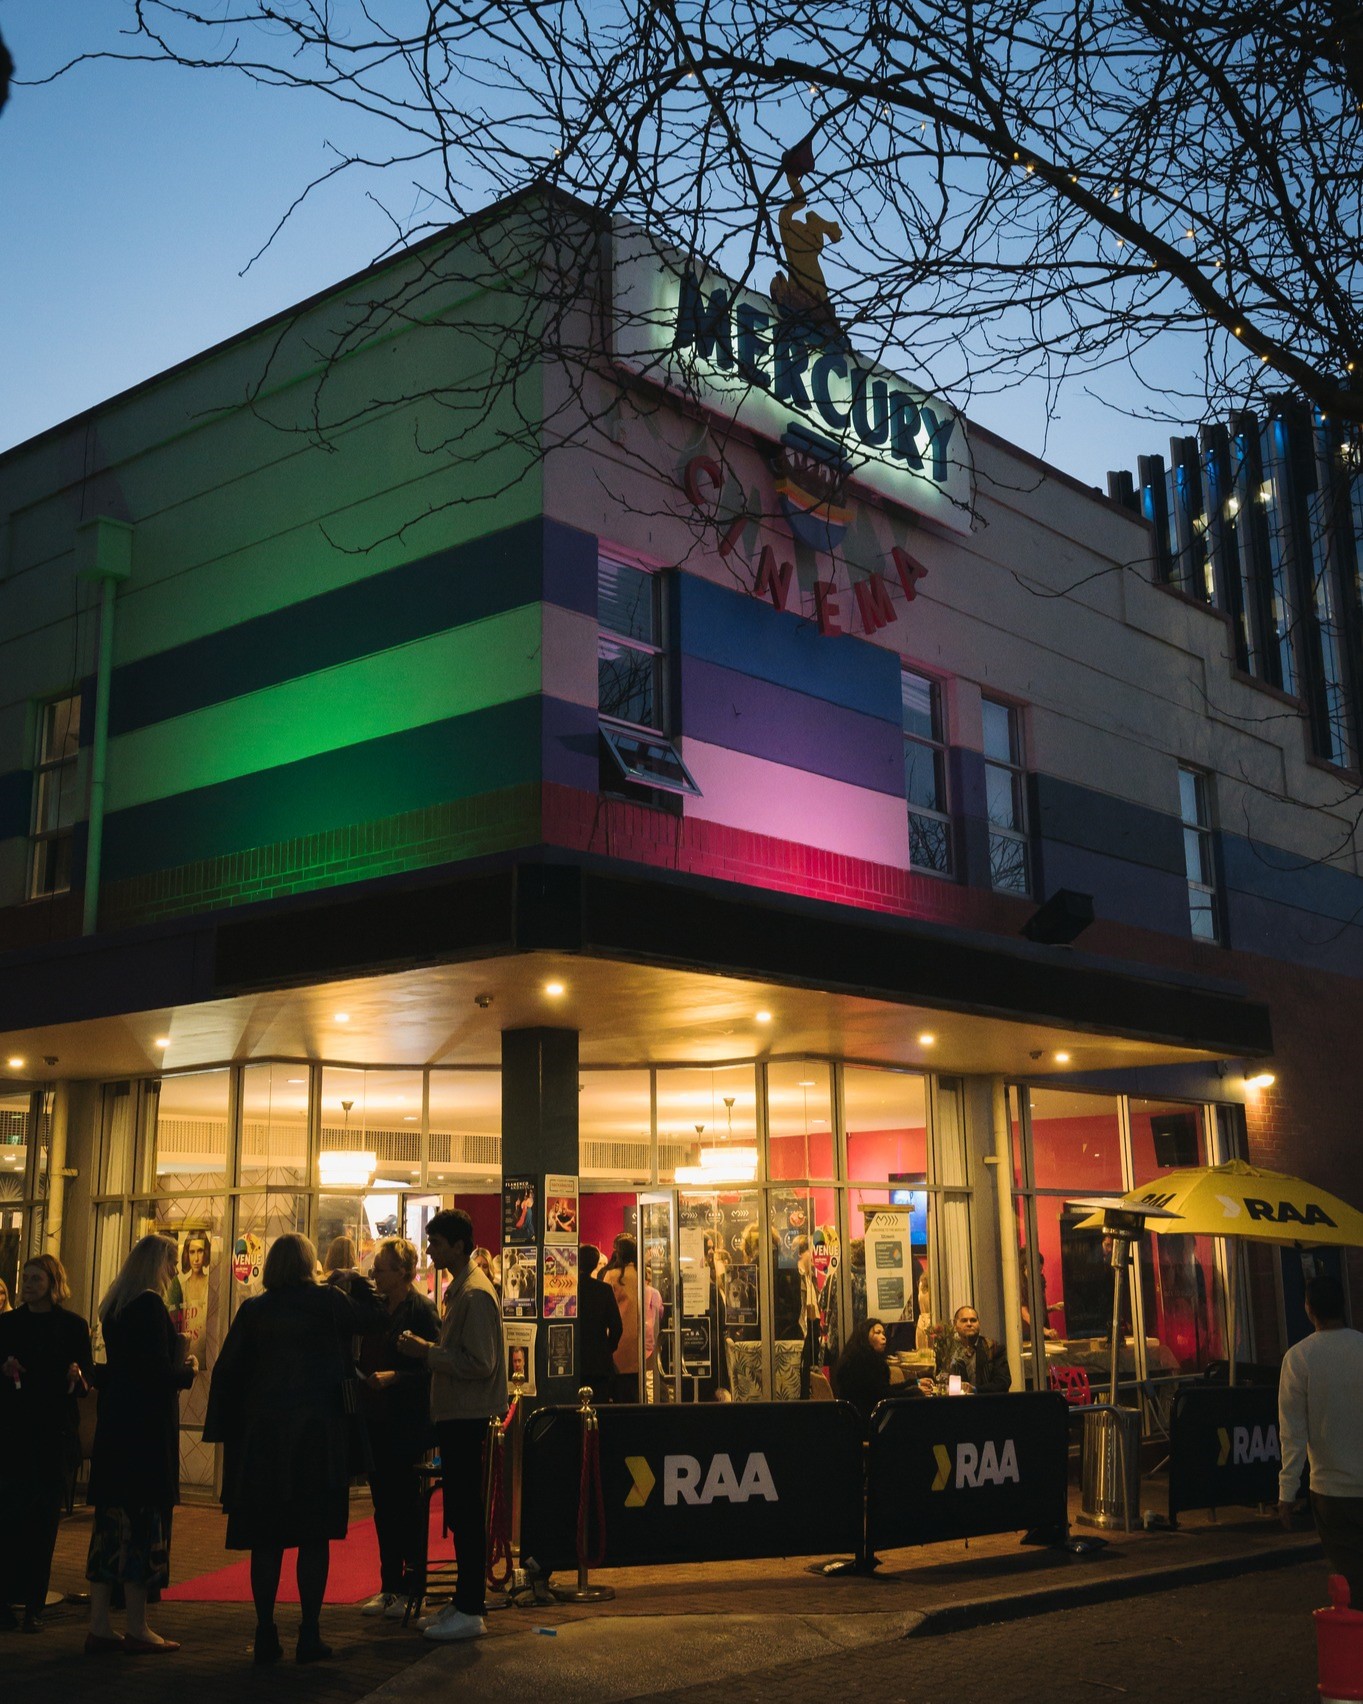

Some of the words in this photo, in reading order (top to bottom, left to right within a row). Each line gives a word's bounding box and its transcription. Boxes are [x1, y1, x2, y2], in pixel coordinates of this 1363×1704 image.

[676, 272, 956, 483] MERCURY
[684, 455, 929, 637] CINEMA
[1243, 1197, 1338, 1228] RAA
[234, 1254, 262, 1266] VENUE
[813, 1245, 839, 1257] VENUE
[955, 1438, 1020, 1489] RAA
[1233, 1424, 1281, 1465] RAA
[664, 1451, 779, 1507] RAA
